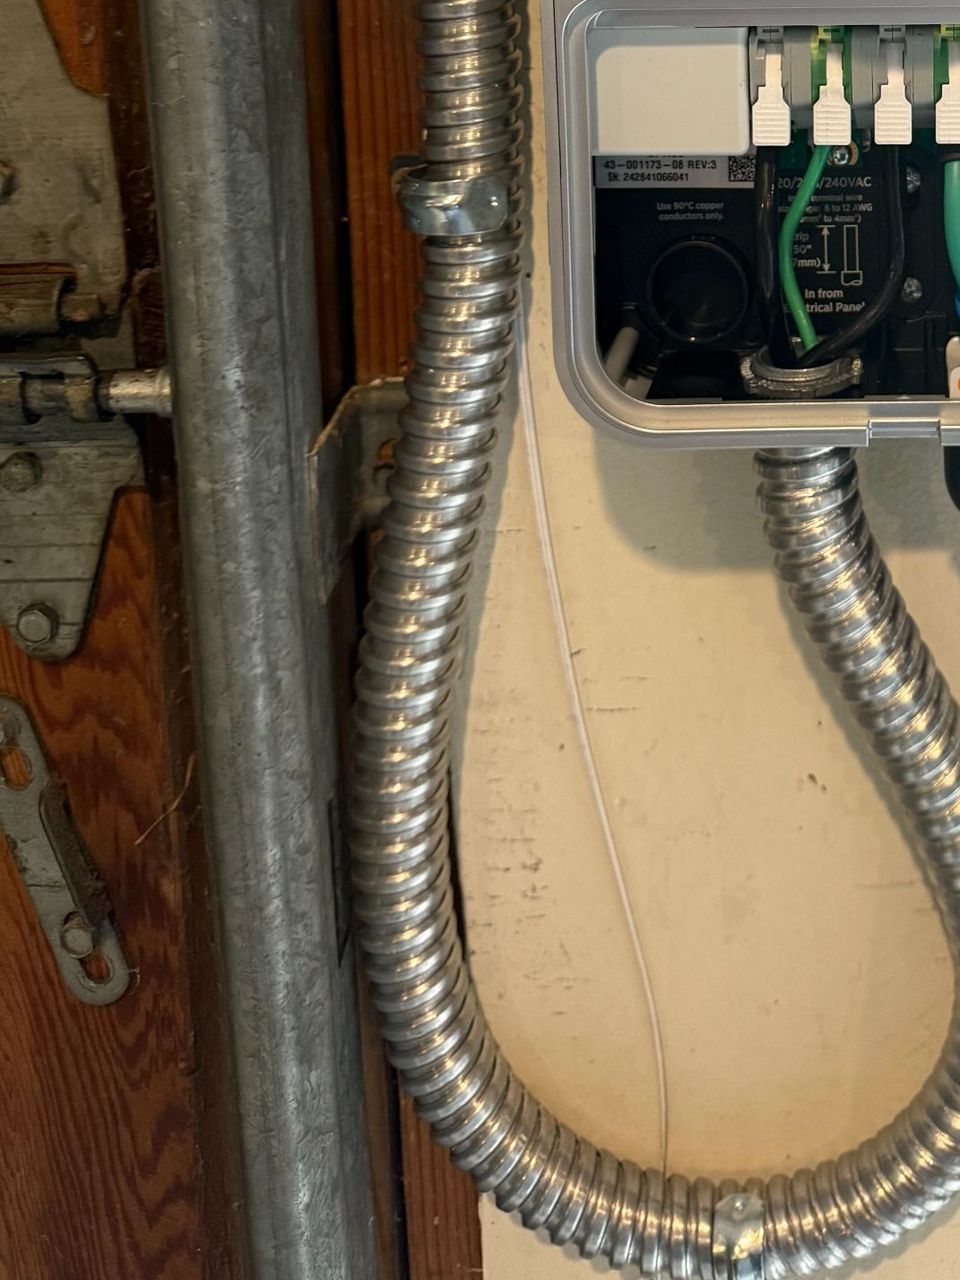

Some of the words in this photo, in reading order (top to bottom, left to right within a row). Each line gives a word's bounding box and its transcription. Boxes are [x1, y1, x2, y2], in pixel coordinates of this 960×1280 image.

[695, 202, 724, 211] copper
[852, 203, 873, 212] AWG
[805, 288, 815, 298] In
[818, 288, 844, 298] from
